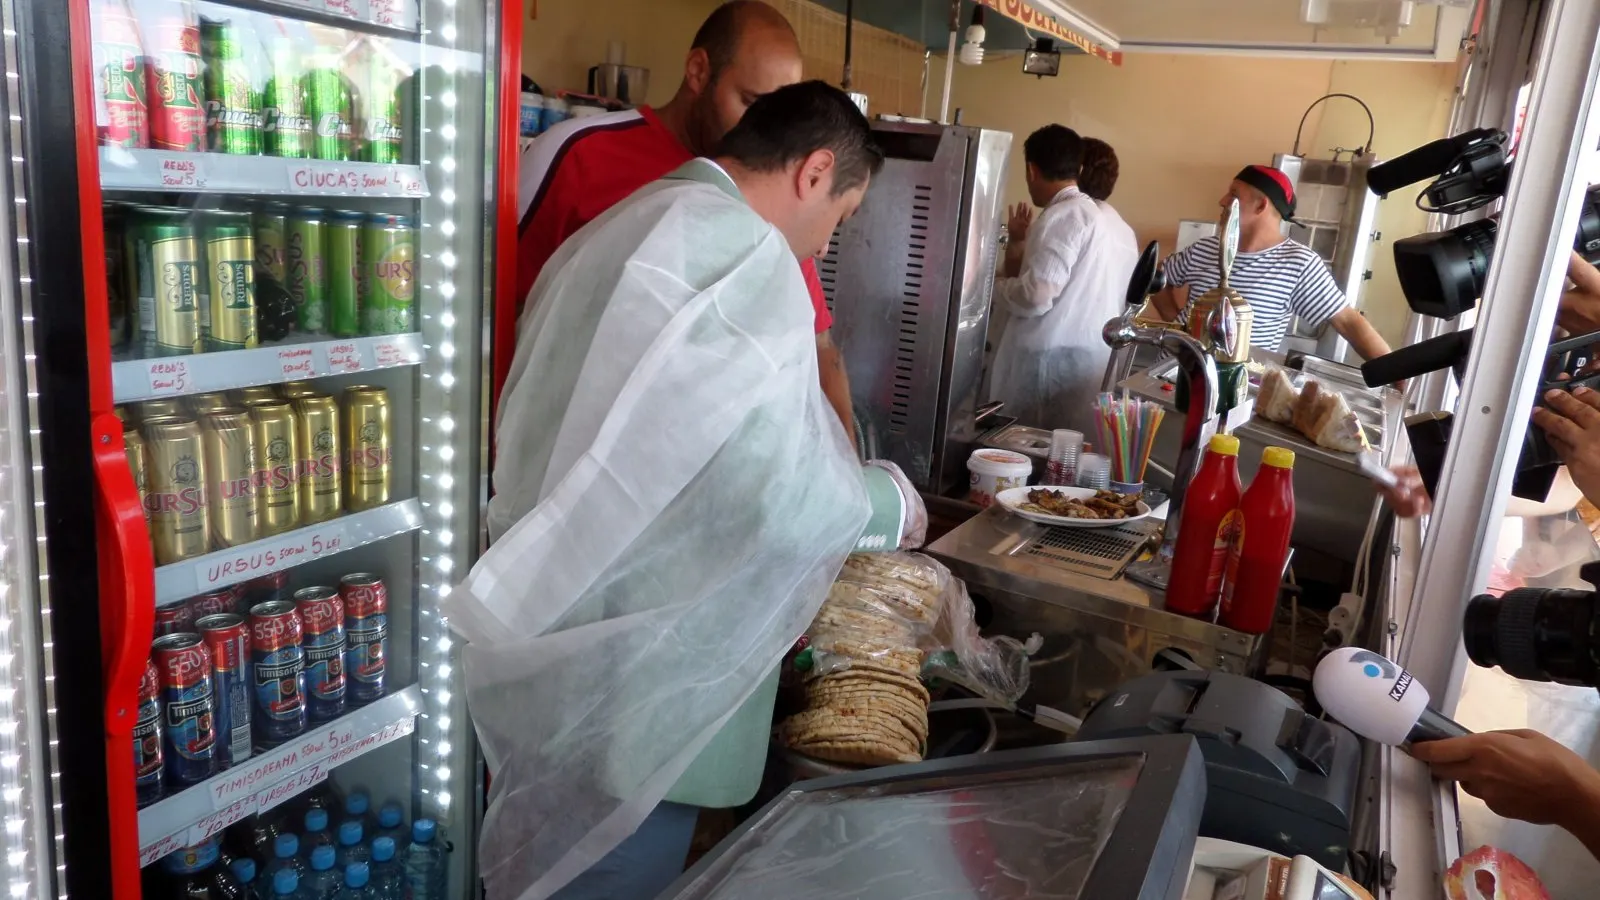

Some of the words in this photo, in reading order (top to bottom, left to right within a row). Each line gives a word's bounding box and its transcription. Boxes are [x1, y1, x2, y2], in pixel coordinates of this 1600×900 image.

[182, 264, 192, 305] REDD'S
[235, 263, 245, 303] REDD'S
[175, 372, 186, 391] 5
[208, 550, 276, 582] URSUS
[311, 534, 323, 554] 5
[326, 538, 341, 549] LEI
[347, 588, 374, 608] 550
[303, 601, 332, 624] 550
[254, 619, 285, 640] 550
[168, 650, 201, 677] 550
[328, 731, 339, 749] 5
[261, 780, 295, 806] URSUS
